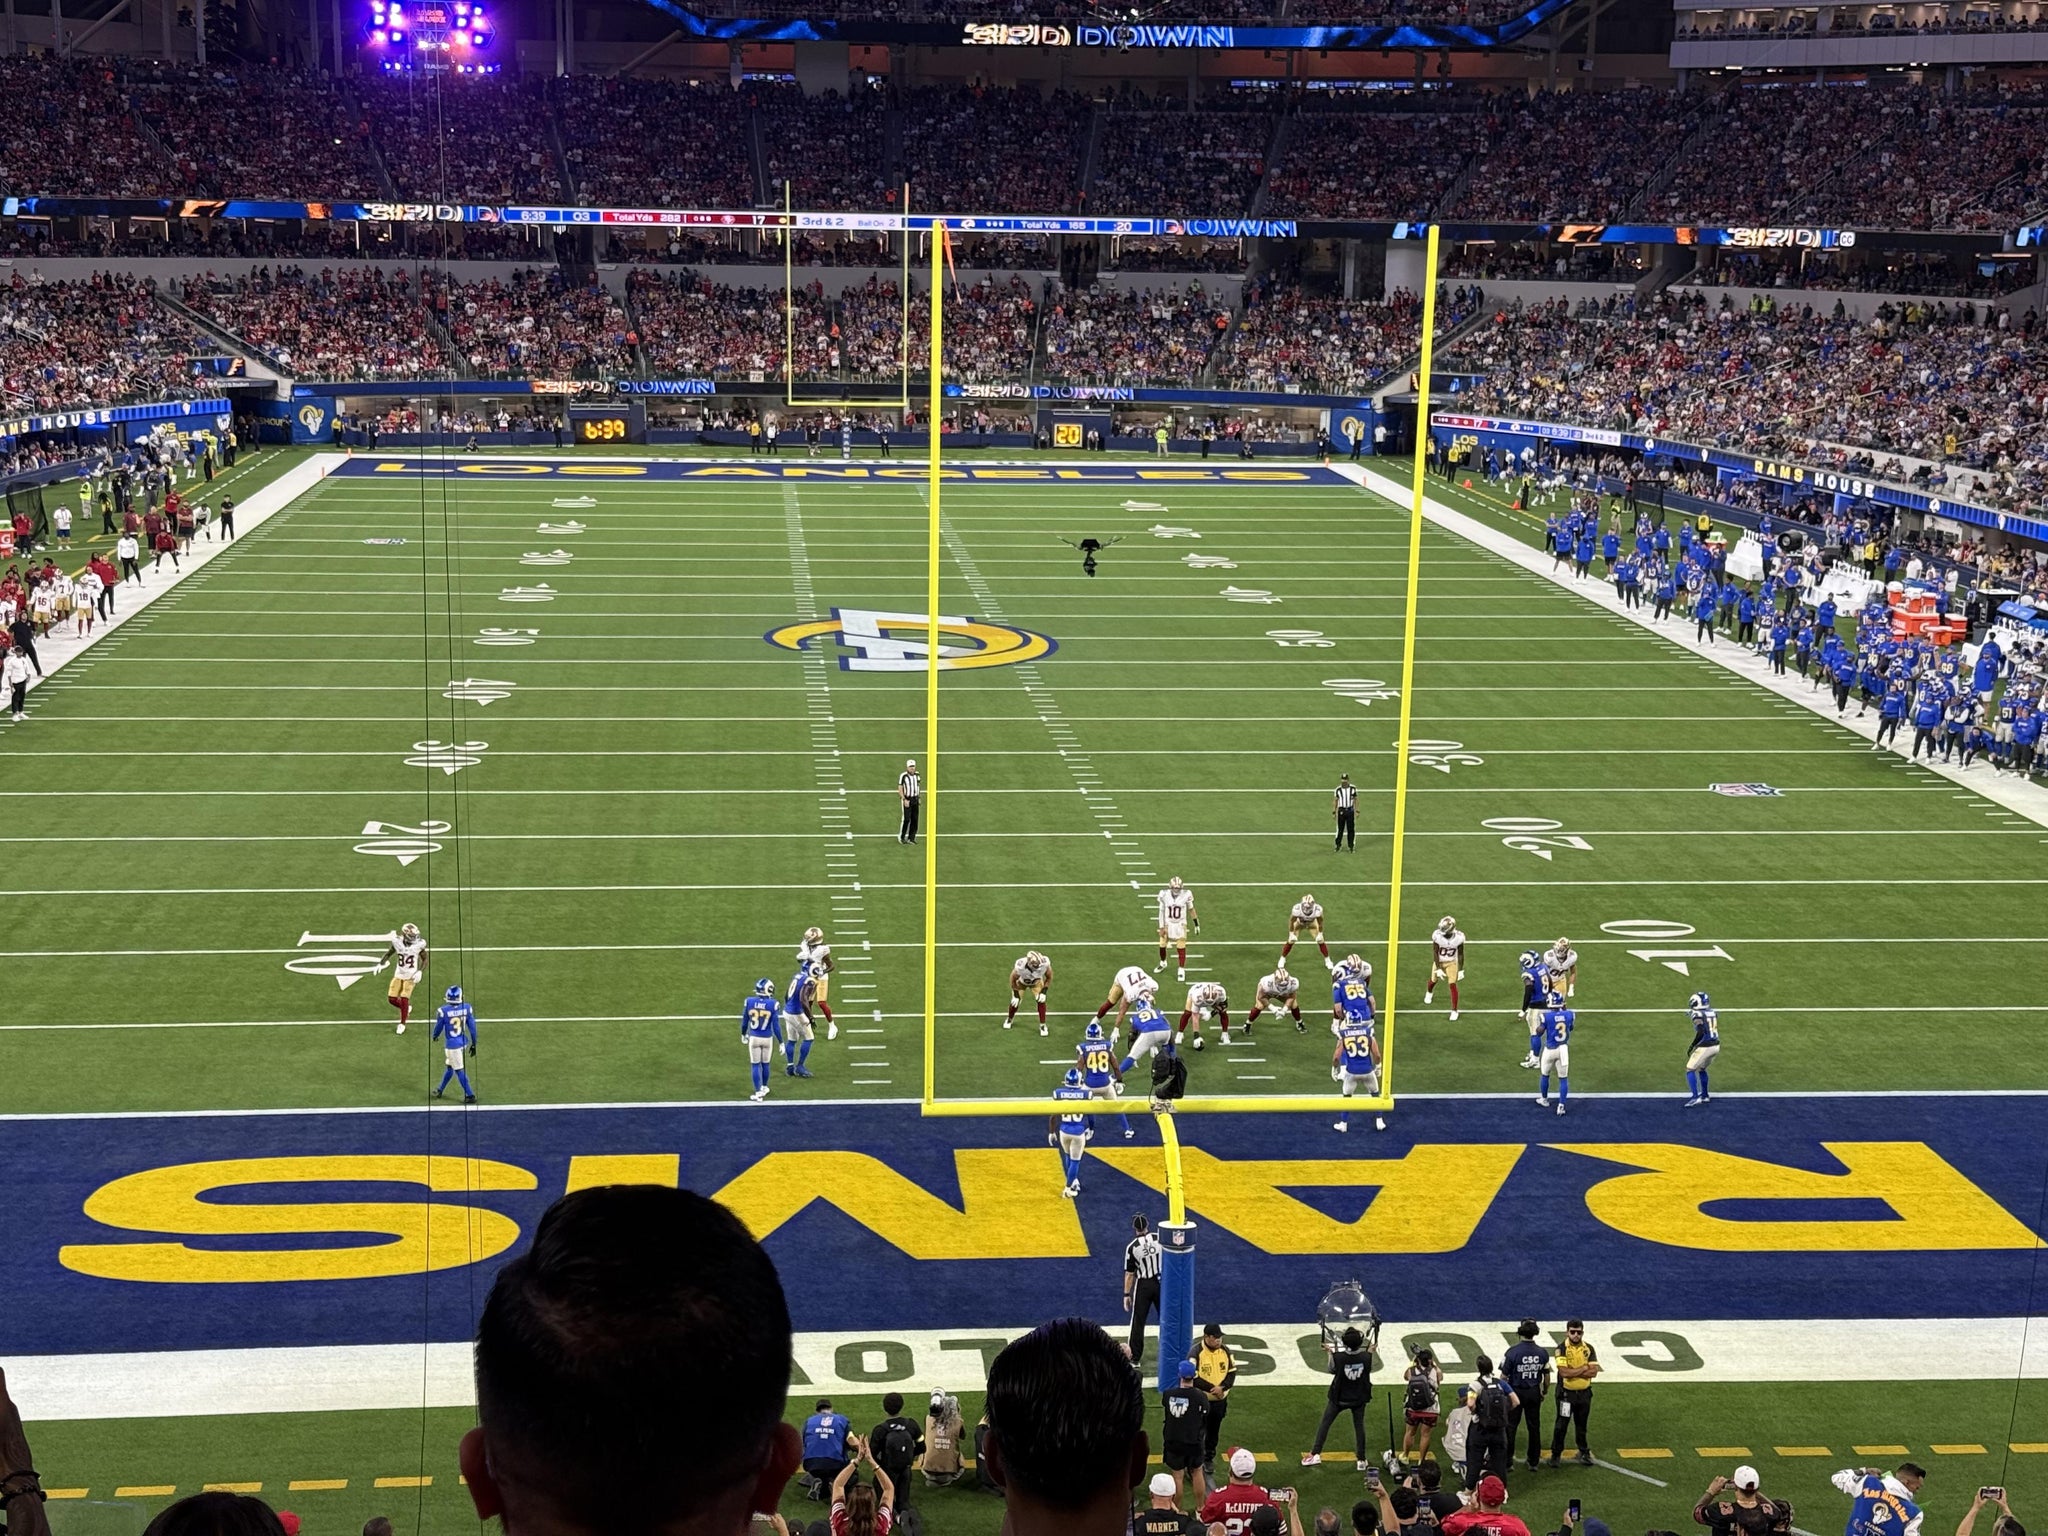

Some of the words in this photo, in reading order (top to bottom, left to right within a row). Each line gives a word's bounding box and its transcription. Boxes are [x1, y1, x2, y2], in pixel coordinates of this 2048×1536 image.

[521, 211, 546, 221] 6:39
[613, 213, 634, 221] Total
[635, 214, 654, 222] Yds
[752, 215, 766, 225] 17
[802, 217, 823, 226] 3rd
[825, 218, 833, 226] &
[835, 218, 844, 226] 2
[889, 219, 895, 227] 2
[1021, 220, 1043, 229] Total
[1044, 221, 1060, 229] Yds
[42, 410, 111, 431] HOUSE
[1473, 419, 1483, 428] 17
[1492, 421, 1500, 430] 7
[585, 419, 625, 439] 6:39
[1057, 425, 1080, 444] 20
[1453, 433, 1479, 447] LOS
[374, 463, 648, 476] LOS
[681, 467, 1311, 481] ANGELES
[1753, 459, 1804, 483] RAMS
[1814, 471, 1875, 498] HOUSE
[1761, 615, 1772, 625] 22
[403, 740, 489, 768] 30
[1392, 739, 1484, 766] 30
[353, 820, 453, 856] 20
[1481, 817, 1595, 851] 20
[1168, 905, 1182, 919] 10
[1600, 919, 1735, 962] 10
[284, 930, 397, 975] 10
[398, 953, 415, 969] 84
[749, 1009, 771, 1031] 37
[1138, 1008, 1158, 1023] 91
[1554, 1021, 1567, 1043] 3
[1344, 1035, 1370, 1058] 53
[1086, 1051, 1109, 1074] 48
[59, 1141, 2048, 1283] RAMS
[1142, 1247, 1156, 1257] 30
[1522, 1355, 1540, 1364] CSC
[1517, 1363, 1544, 1373] SECURITY
[1522, 1371, 1538, 1380] FIT
[1146, 1520, 1179, 1534] WARNER
